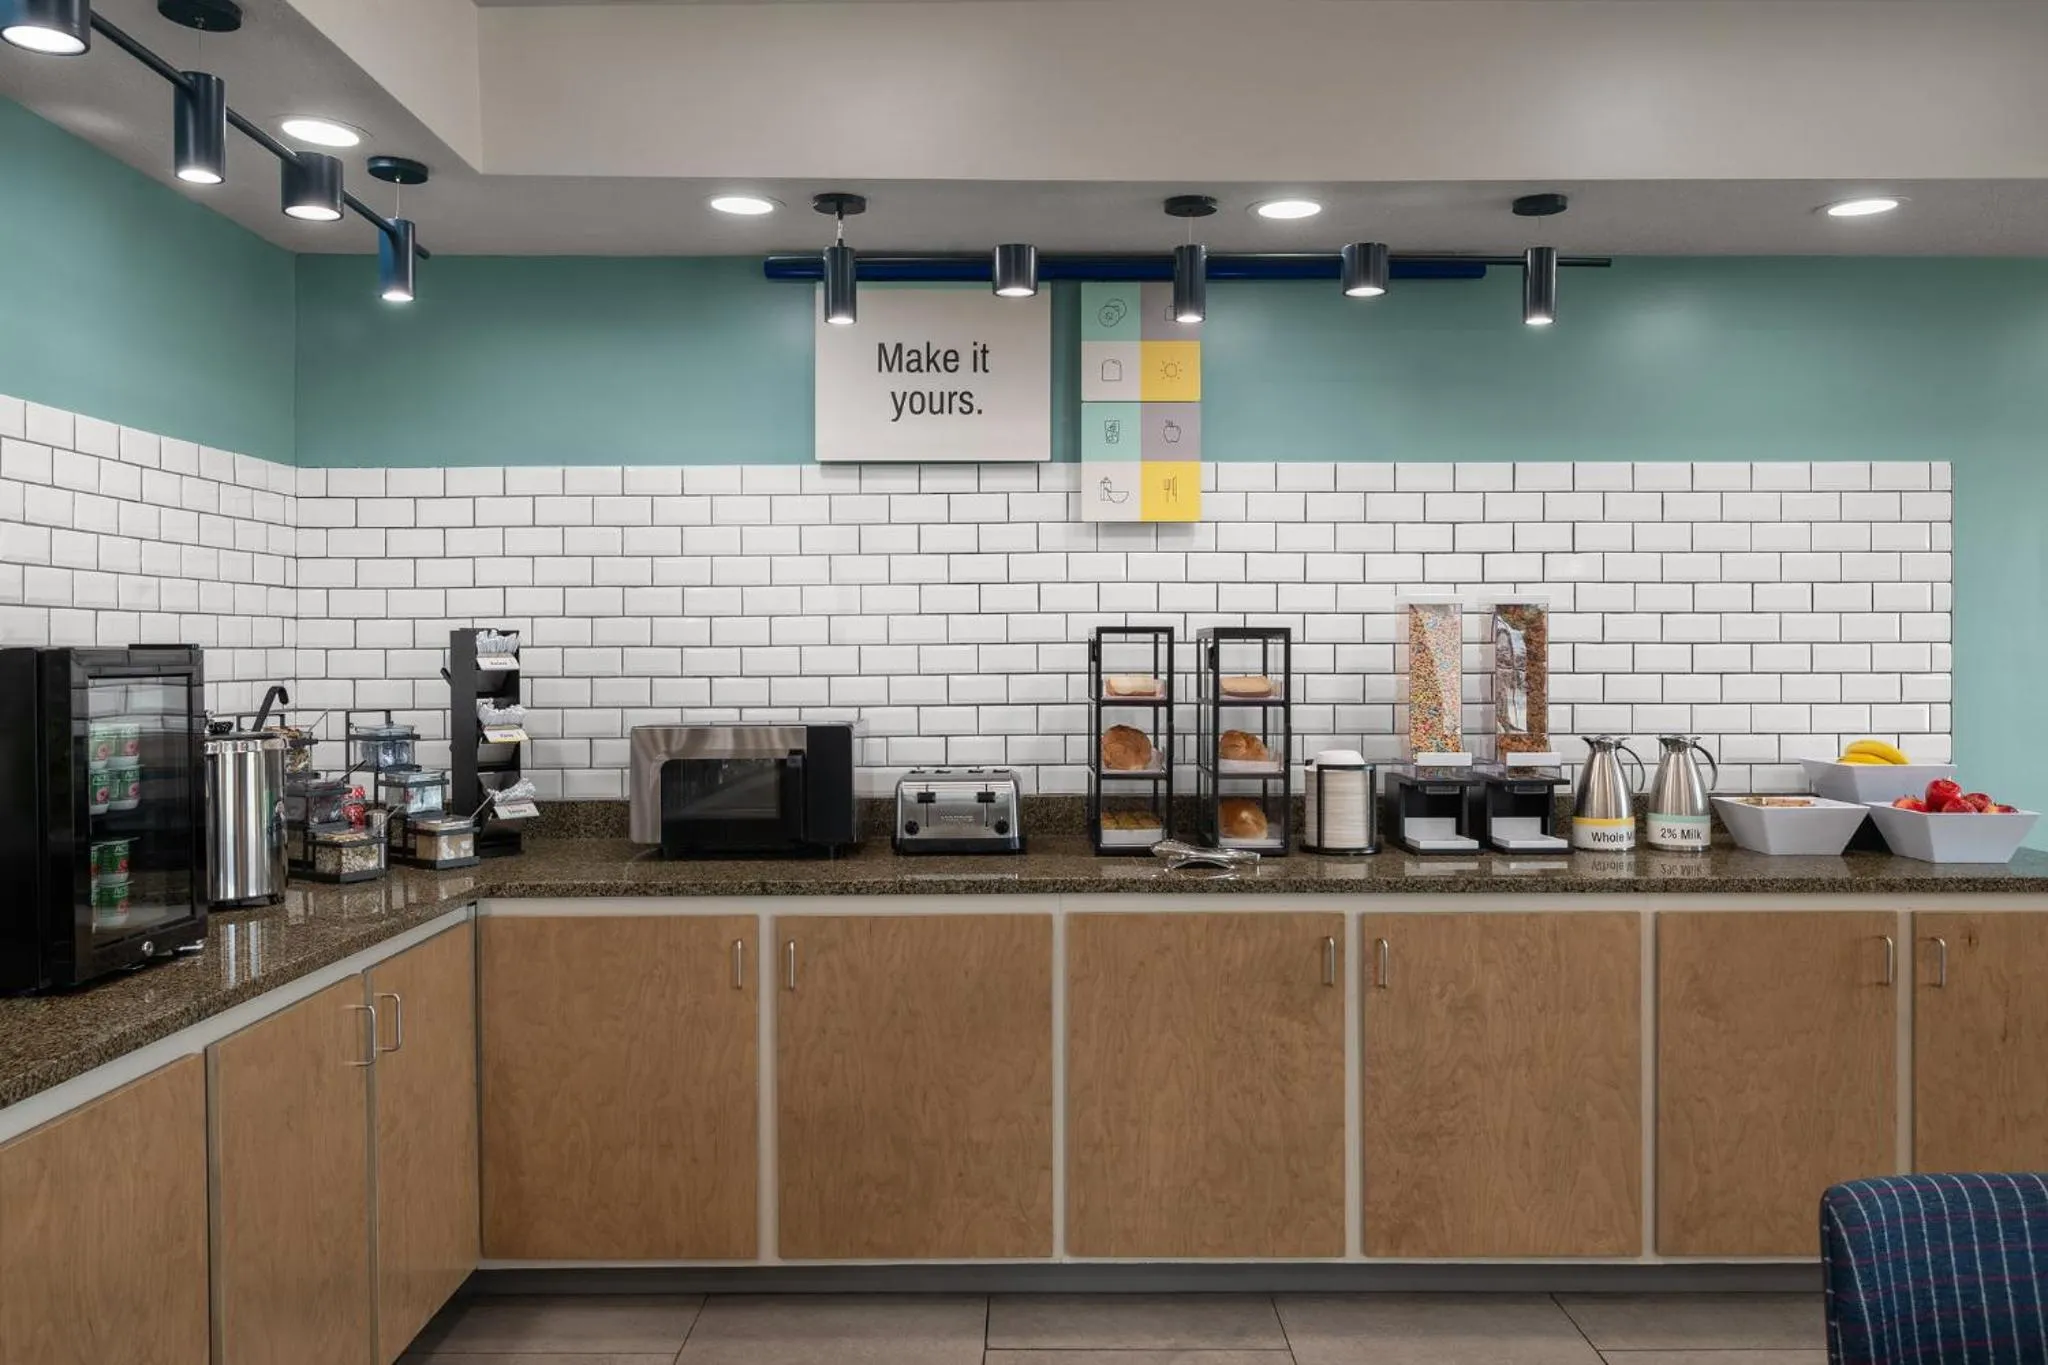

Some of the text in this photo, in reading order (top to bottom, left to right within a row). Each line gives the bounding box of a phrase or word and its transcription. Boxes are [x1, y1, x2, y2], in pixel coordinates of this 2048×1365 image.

[878, 341, 990, 373] Make it
[890, 391, 983, 422] yours.
[1591, 831, 1624, 842] Whole
[1660, 827, 1702, 840] 2% Milk
